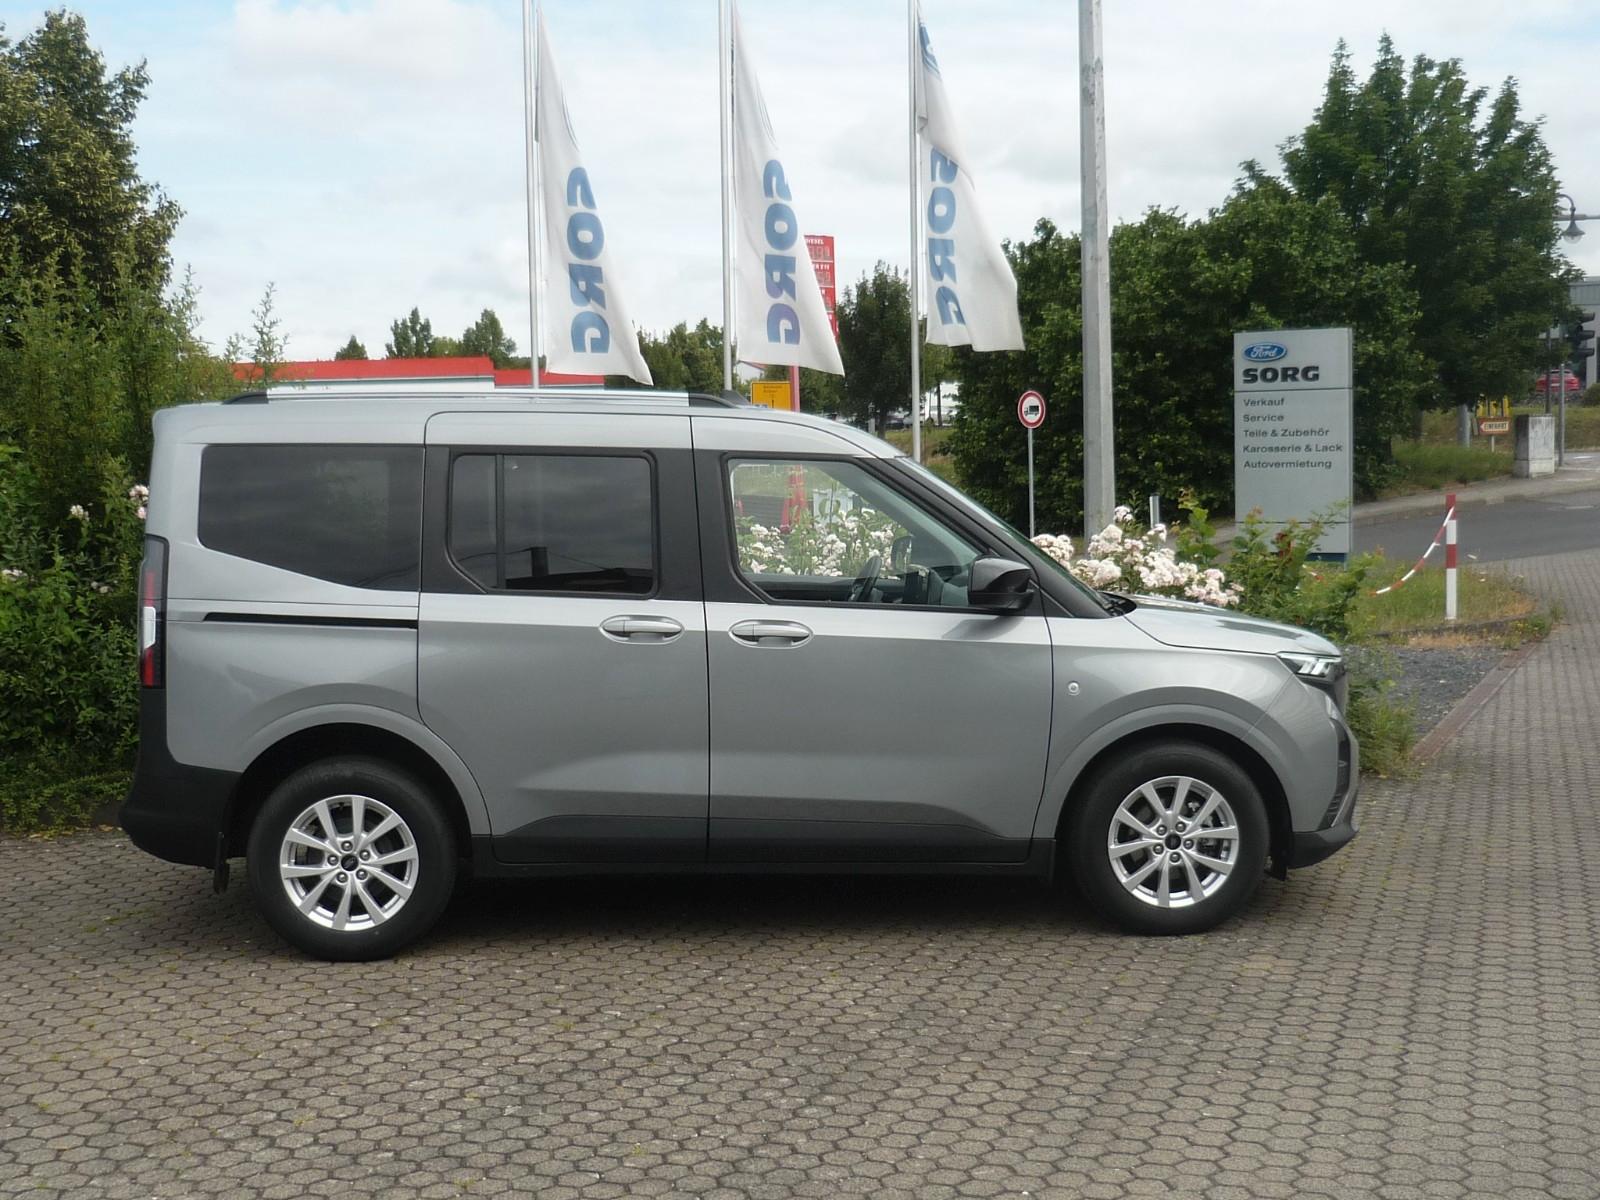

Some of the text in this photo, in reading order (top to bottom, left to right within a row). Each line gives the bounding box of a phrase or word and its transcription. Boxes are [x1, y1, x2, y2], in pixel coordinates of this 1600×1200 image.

[1242, 366, 1320, 384] SORG
[1243, 398, 1285, 407] Verkauf
[1243, 414, 1285, 423] Service
[1243, 427, 1330, 438] Teile & Zubehör
[1243, 443, 1343, 454] Karosserie & Lack
[1243, 460, 1332, 470] Autovermietung
